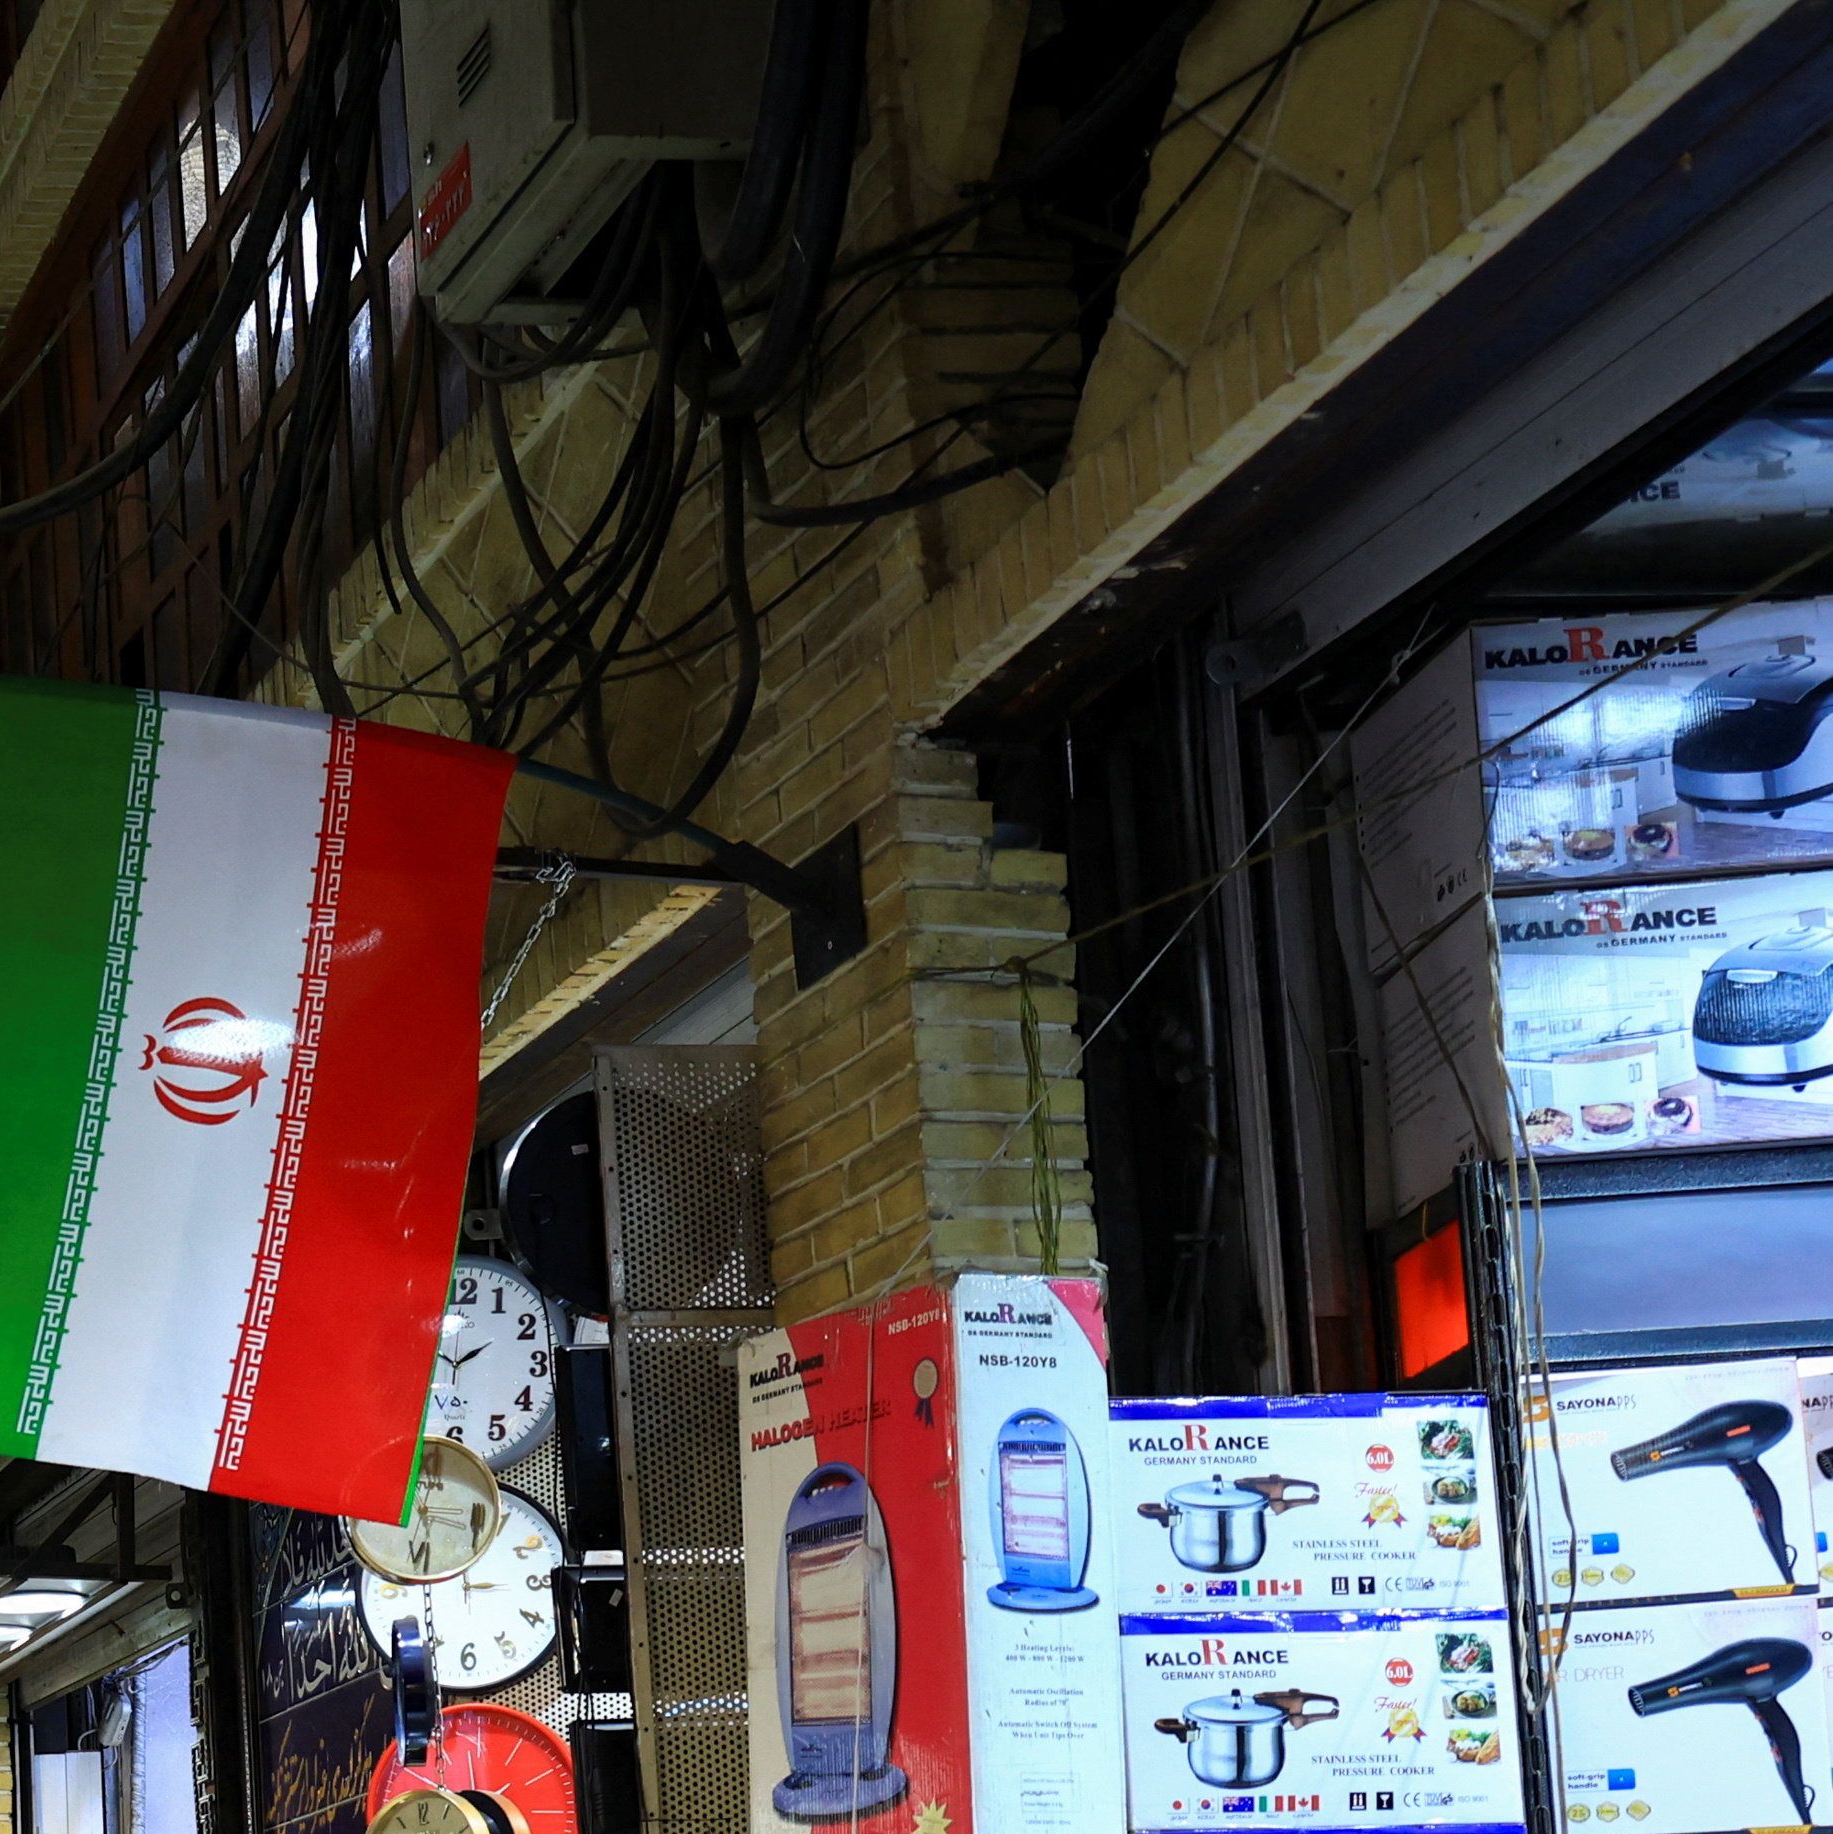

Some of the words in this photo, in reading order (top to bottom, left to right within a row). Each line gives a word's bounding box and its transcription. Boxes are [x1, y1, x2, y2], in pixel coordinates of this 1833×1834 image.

[1611, 934, 1676, 948] GERMANY
[1680, 931, 1727, 942] STANDARD
[979, 1354, 1057, 1368] NSB-120Y8
[751, 1414, 825, 1452] HALOGEN
[1144, 1456, 1197, 1466] GERMANY
[1200, 1455, 1257, 1465] STANDARD
[1292, 1540, 1347, 1549] STAINLESS
[1349, 1539, 1383, 1548] STEEL
[1313, 1552, 1366, 1562] PRESSURE
[1371, 1551, 1417, 1560] COOKER
[1162, 1672, 1215, 1680] GERMANY
[1219, 1670, 1276, 1679] STANDARD
[1312, 1755, 1366, 1764] STAINLESS
[1369, 1754, 1401, 1763] STEEL
[1332, 1768, 1385, 1777] PRESSURE
[1390, 1766, 1435, 1776] COOKER
